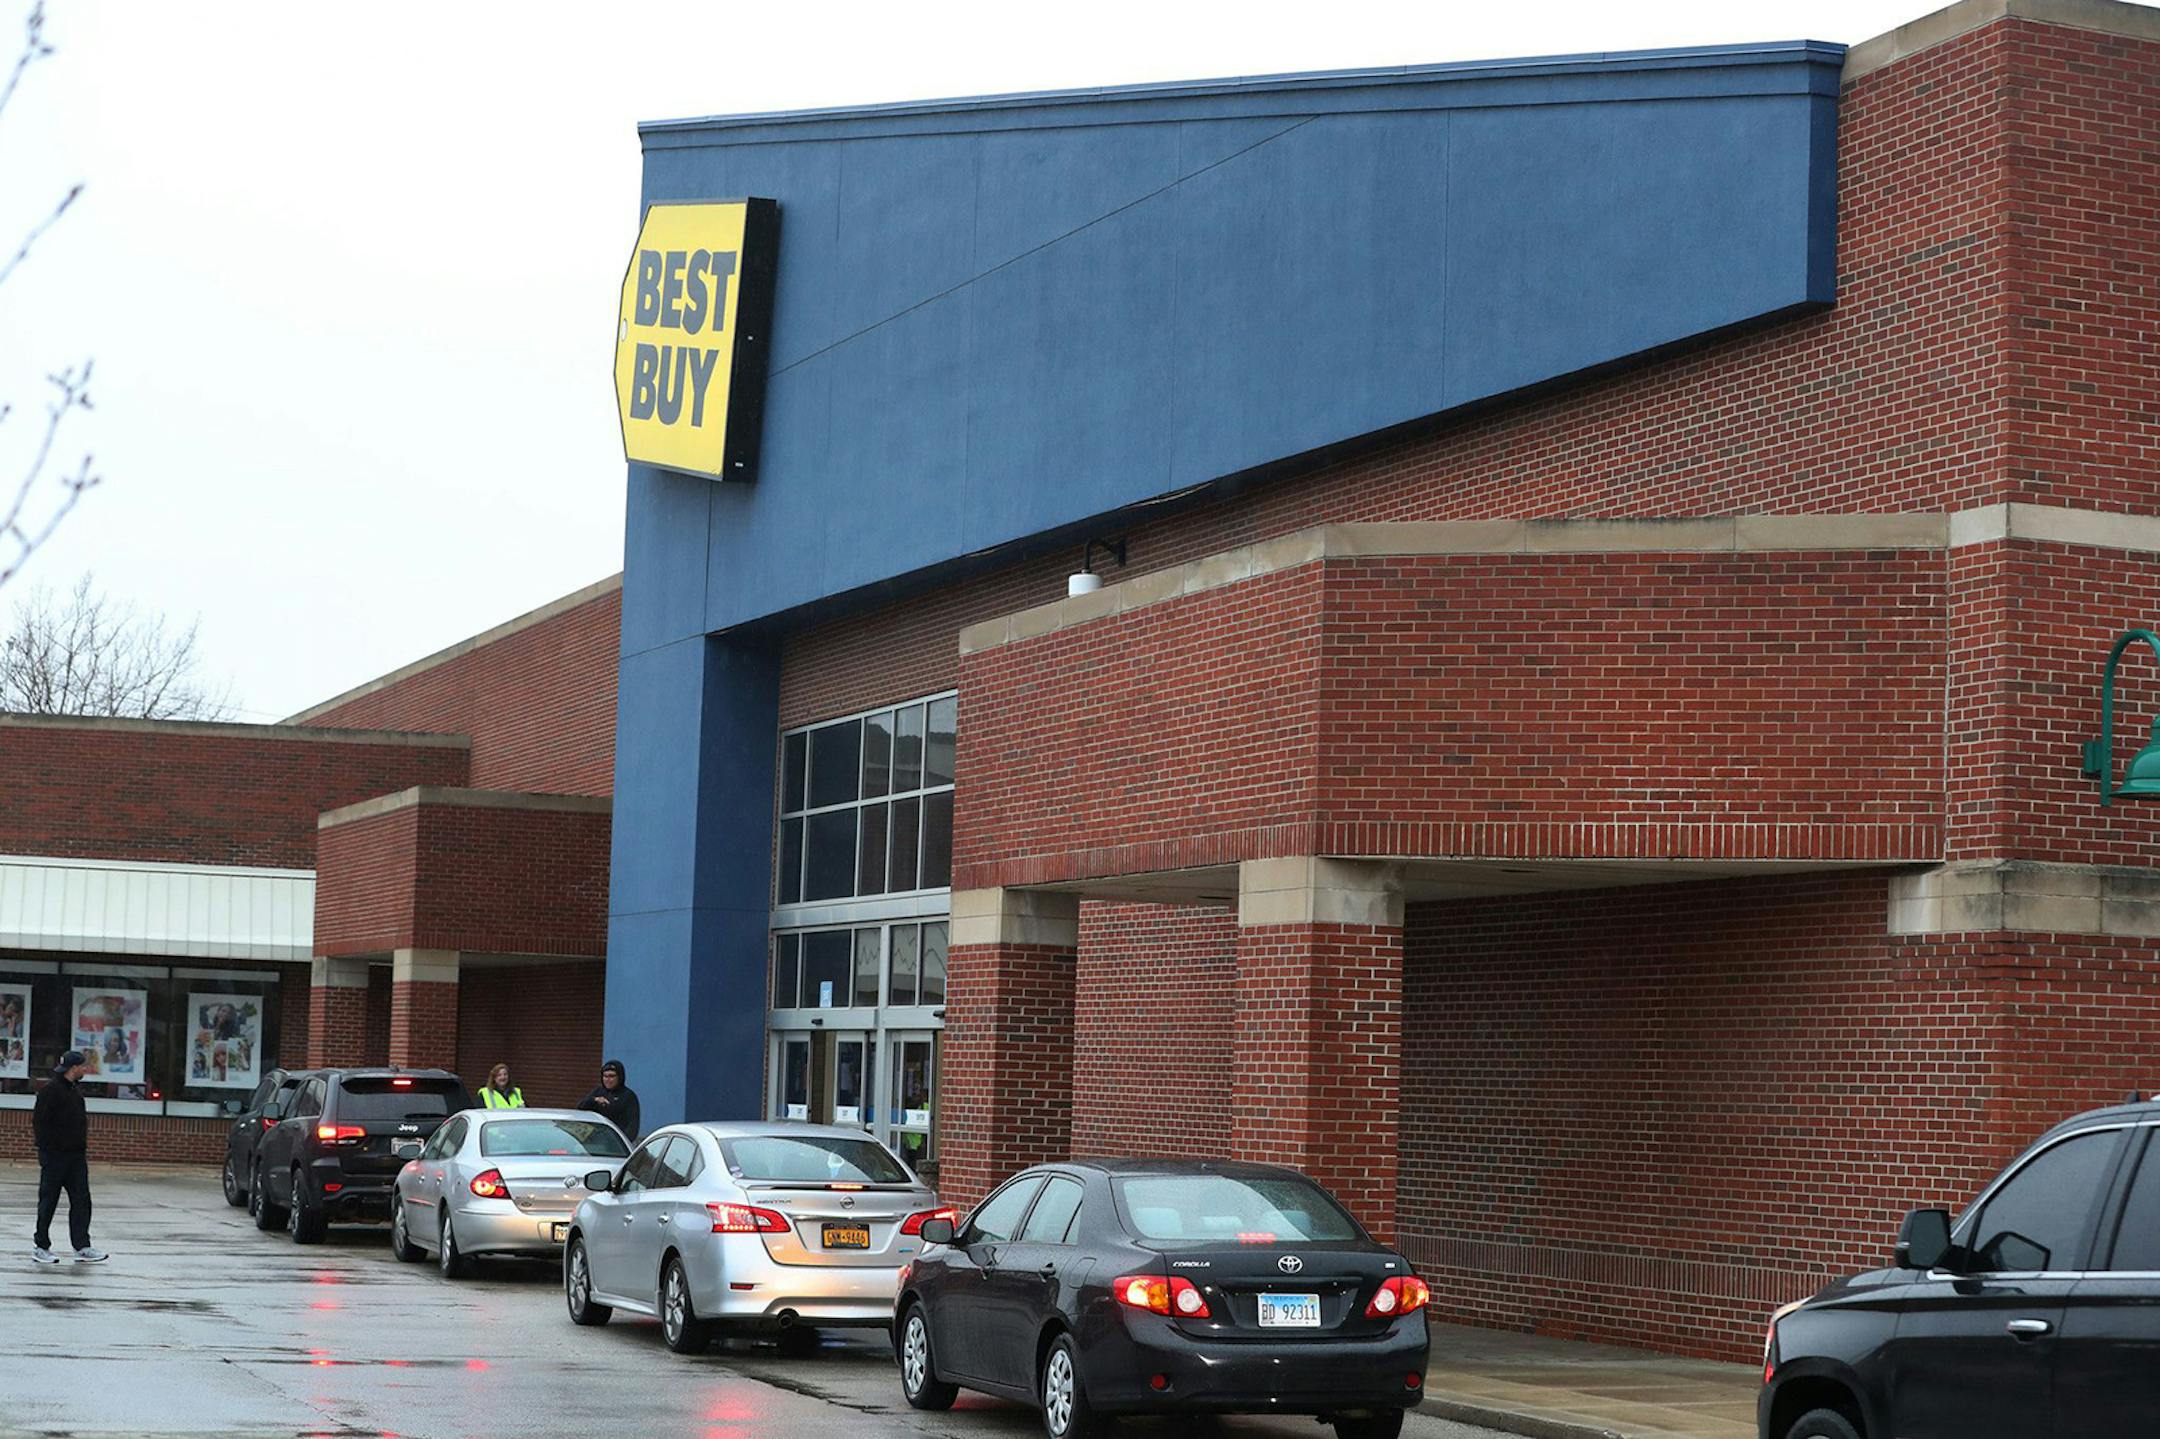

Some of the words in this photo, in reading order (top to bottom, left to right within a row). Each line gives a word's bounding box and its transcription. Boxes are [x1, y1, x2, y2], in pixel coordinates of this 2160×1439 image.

[634, 249, 738, 335] BEST
[630, 343, 719, 428] BUY
[398, 1123, 419, 1133] Jeep
[1172, 1260, 1211, 1268] COROLLA
[1261, 1303, 1276, 1320] BD
[1282, 1304, 1317, 1321] 92311
